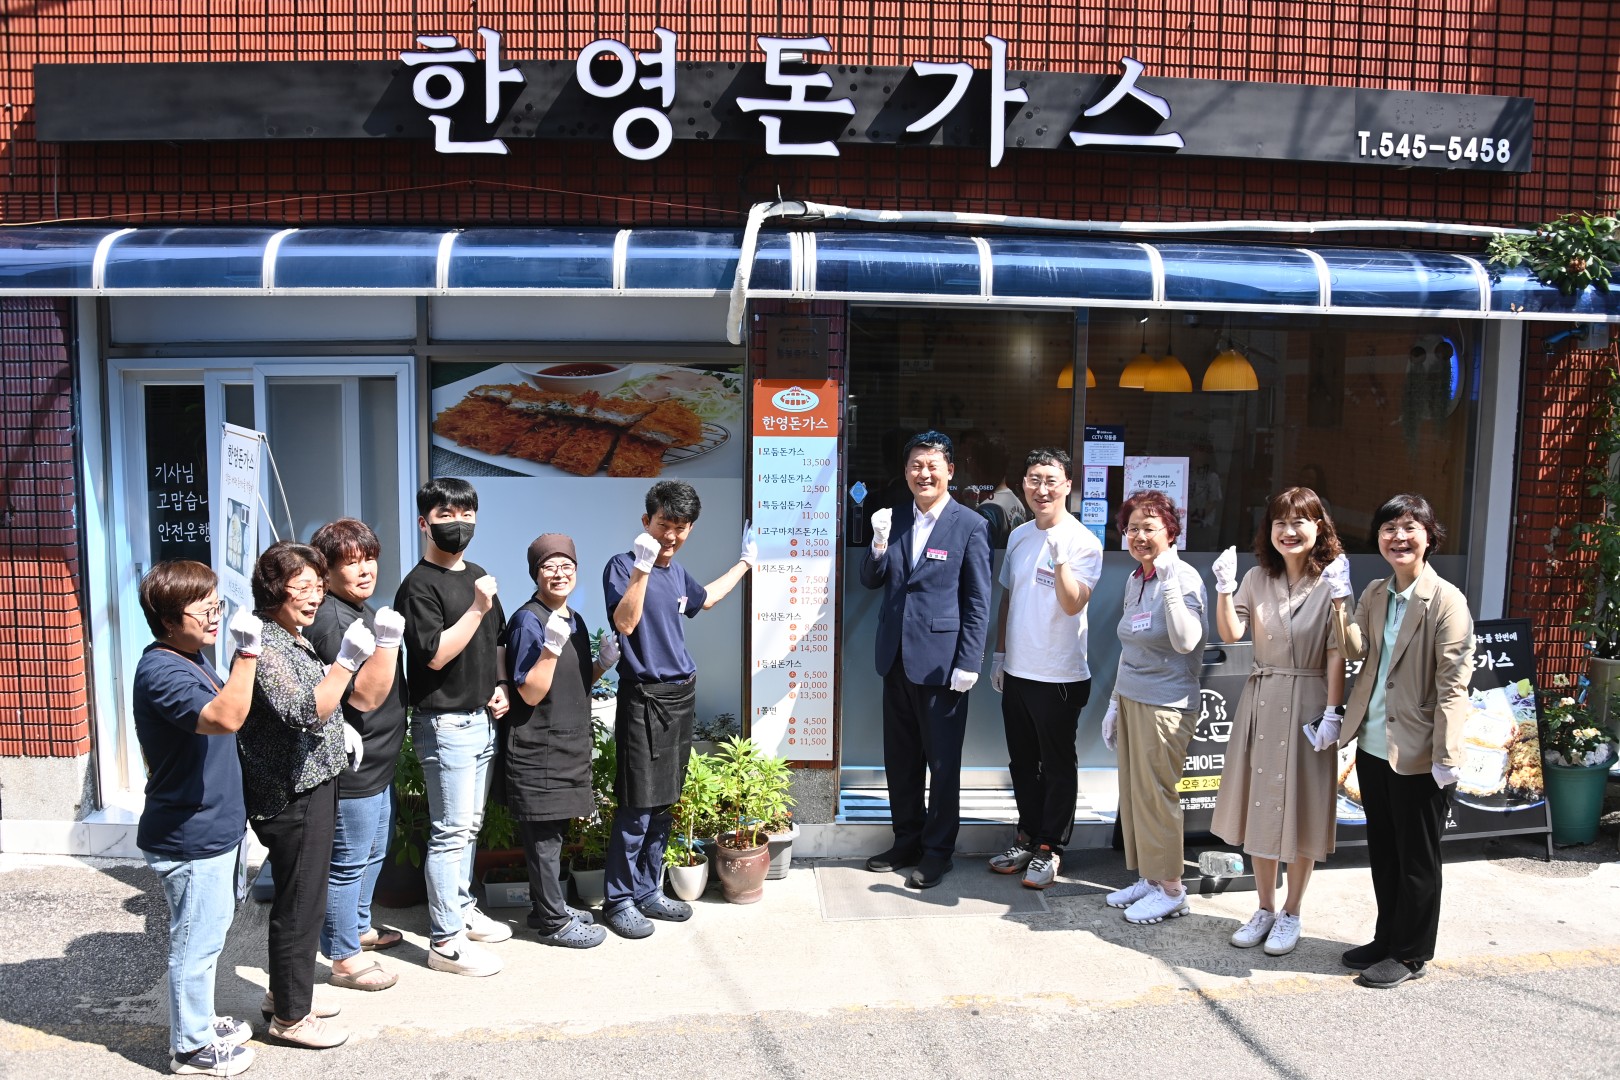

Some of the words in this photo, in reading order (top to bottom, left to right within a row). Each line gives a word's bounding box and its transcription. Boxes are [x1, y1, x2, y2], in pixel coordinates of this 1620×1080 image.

[400, 26, 1185, 168] 한영돈가스
[1358, 131, 1511, 163] T.545-5458
[762, 416, 829, 431] 한영돈가스
[763, 448, 805, 457] 모듬돈가스
[802, 459, 831, 467] 13,500
[155, 463, 194, 483] 기사님
[763, 474, 813, 483] 상등심돈가스
[1137, 479, 1177, 488] 한영돈가스
[802, 485, 830, 494] 12,500
[762, 501, 813, 510] 특등심돈가스
[802, 512, 830, 520] 11,000
[158, 522, 212, 543] 안전운행
[762, 527, 828, 537] 고구마치즈돈가스
[805, 539, 829, 547] 8,500
[801, 549, 829, 558] 14,500
[762, 565, 803, 574] 치즈돈가스
[805, 576, 829, 584] 7,500
[801, 586, 829, 595] 12,500
[801, 597, 829, 605] 17,500
[761, 612, 802, 621] 안심돈가스
[805, 624, 828, 632] 8,500
[801, 634, 828, 642] 11,500
[1494, 632, 1518, 643] 한번에
[801, 645, 828, 653] 14,500
[761, 659, 802, 669] 등심돈가스
[804, 671, 828, 679] 6,500
[800, 682, 828, 690] 10,000
[800, 692, 827, 700] 13,500
[803, 718, 827, 726] 4,500
[803, 728, 827, 736] 8,000
[800, 738, 827, 746] 11,500
[1182, 779, 1200, 789] 오후
